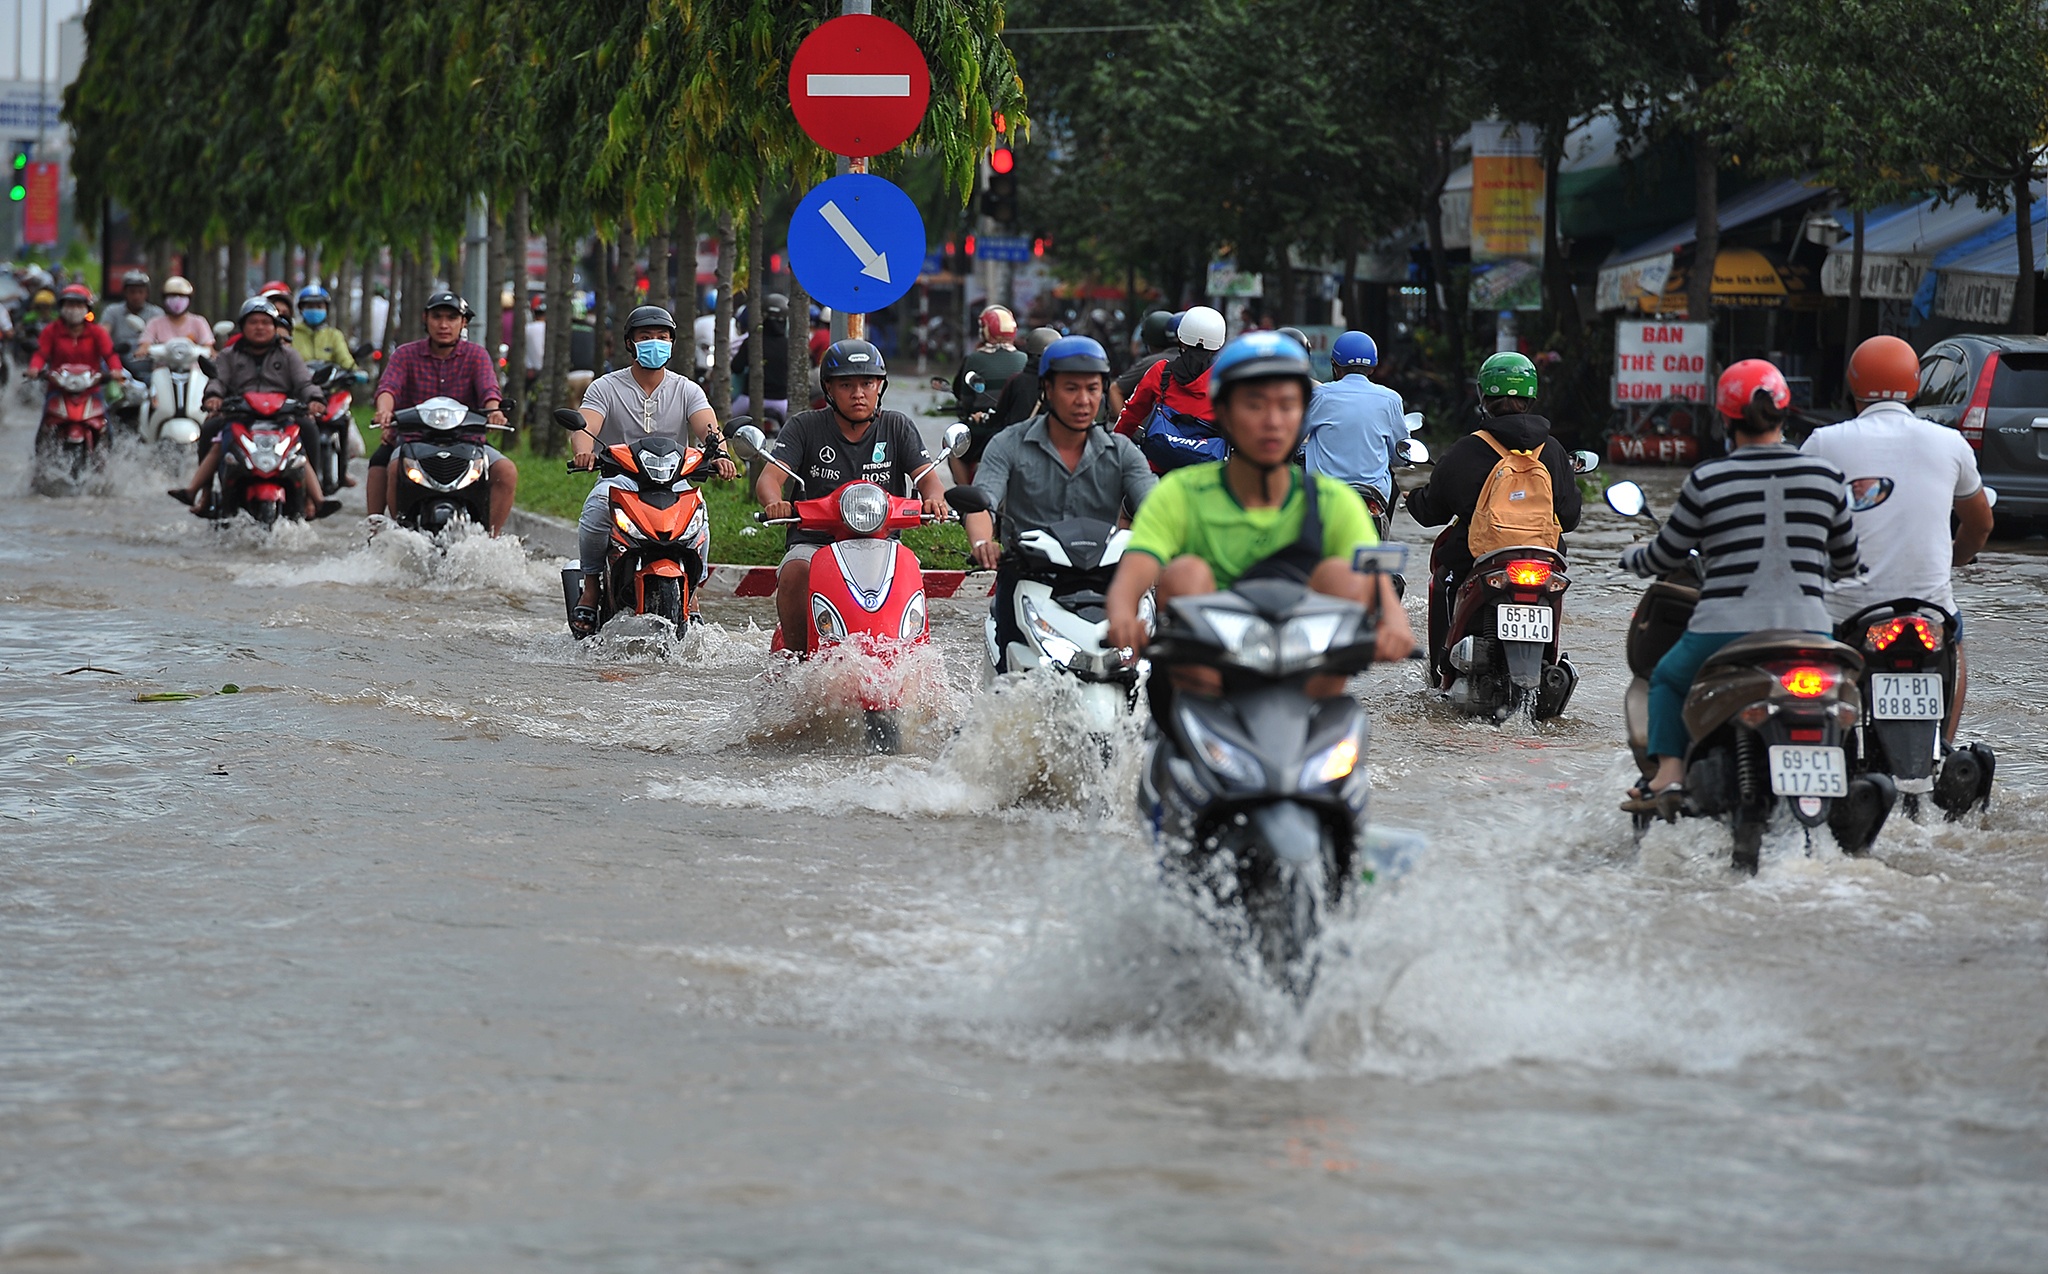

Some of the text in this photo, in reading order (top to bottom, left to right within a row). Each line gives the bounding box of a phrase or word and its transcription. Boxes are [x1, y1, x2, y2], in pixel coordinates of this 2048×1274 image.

[1620, 350, 1655, 371] THẺ
[1998, 426, 2031, 435] CR-V
[820, 467, 891, 483] UBS BOSS
[1506, 607, 1543, 623] 65-B1
[1501, 623, 1549, 639] 991.40
[1882, 677, 1930, 696] 71-B1
[1878, 697, 1938, 716] 888.58
[1782, 750, 1831, 770] 69-C1
[1778, 772, 1841, 793] 117.55
